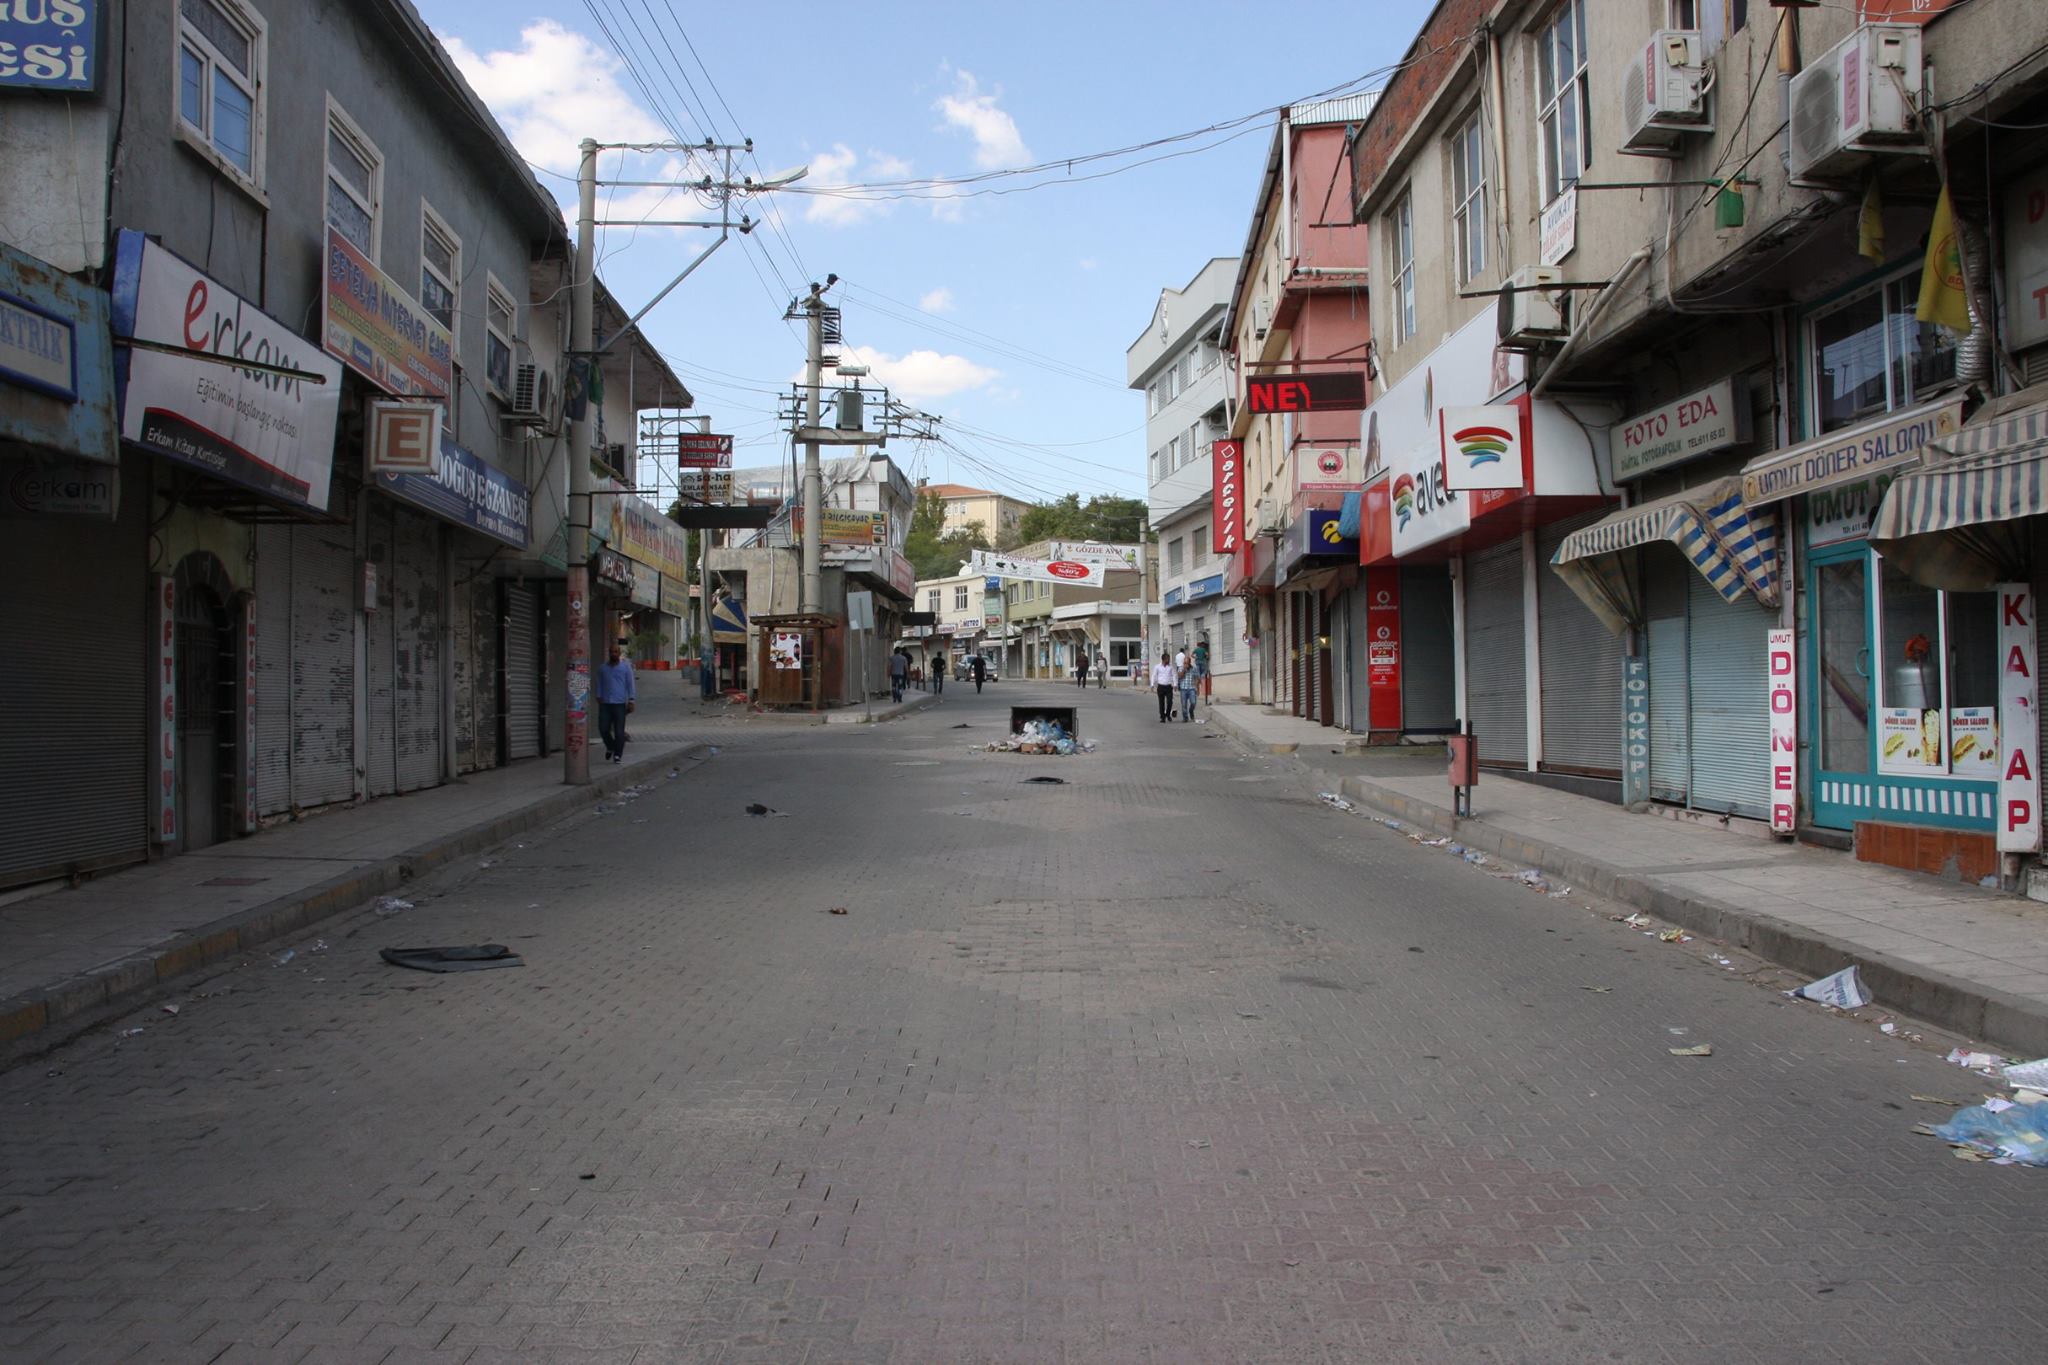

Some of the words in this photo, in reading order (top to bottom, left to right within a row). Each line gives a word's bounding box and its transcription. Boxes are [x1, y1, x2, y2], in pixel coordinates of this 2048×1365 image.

[184, 279, 302, 402] erkam
[147, 427, 174, 450] Erkam
[387, 417, 422, 458] E
[1624, 413, 1668, 448] FOTO
[1678, 394, 1718, 428] EDA
[1758, 462, 1802, 496] UMUT
[1805, 445, 1859, 482] DÖNER
[1863, 419, 1934, 464] SALONU
[1812, 480, 1870, 528] UMUT
[1769, 633, 1792, 644] UMUT
[1770, 651, 1793, 828] DÖNER
[2003, 593, 2033, 832] KAAP
